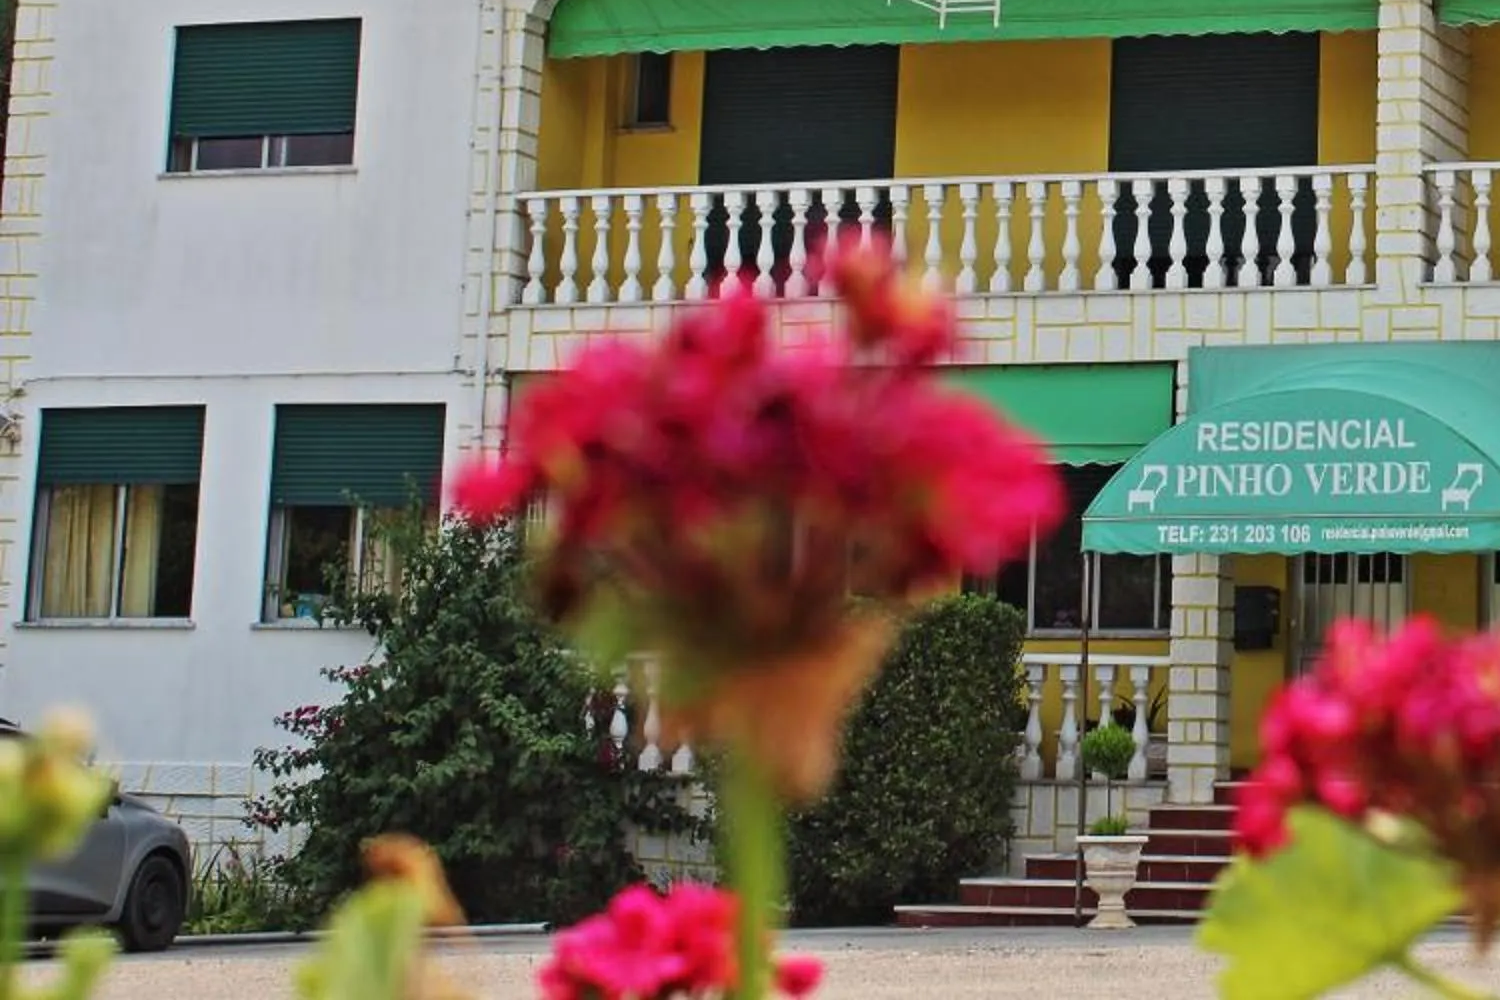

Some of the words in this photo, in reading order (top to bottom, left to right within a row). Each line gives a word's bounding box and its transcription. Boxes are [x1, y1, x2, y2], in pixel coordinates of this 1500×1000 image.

[1198, 418, 1416, 451] RESIDENCIAL
[1174, 463, 1293, 497] PINHO
[1304, 461, 1431, 495] VERDE
[1157, 525, 1204, 543] TELF:
[1209, 525, 1238, 543] 231
[1245, 525, 1275, 543] 203
[1281, 524, 1311, 543] 106
